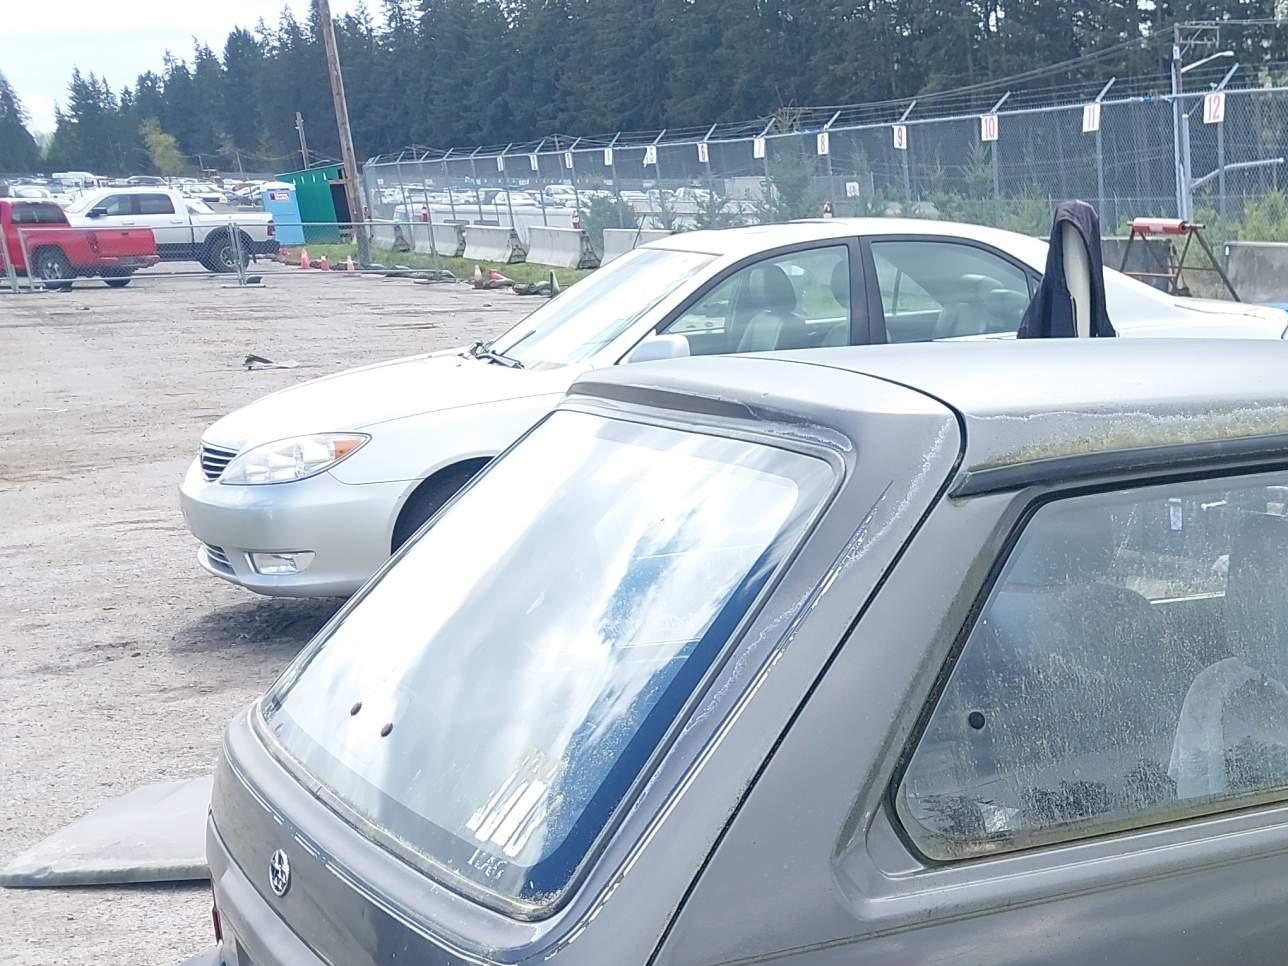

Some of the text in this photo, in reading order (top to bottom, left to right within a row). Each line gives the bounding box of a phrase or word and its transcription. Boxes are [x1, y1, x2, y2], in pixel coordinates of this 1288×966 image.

[1087, 106, 1096, 129] 11
[1206, 95, 1221, 121] 12
[897, 127, 903, 147] 9
[984, 118, 996, 138] 10
